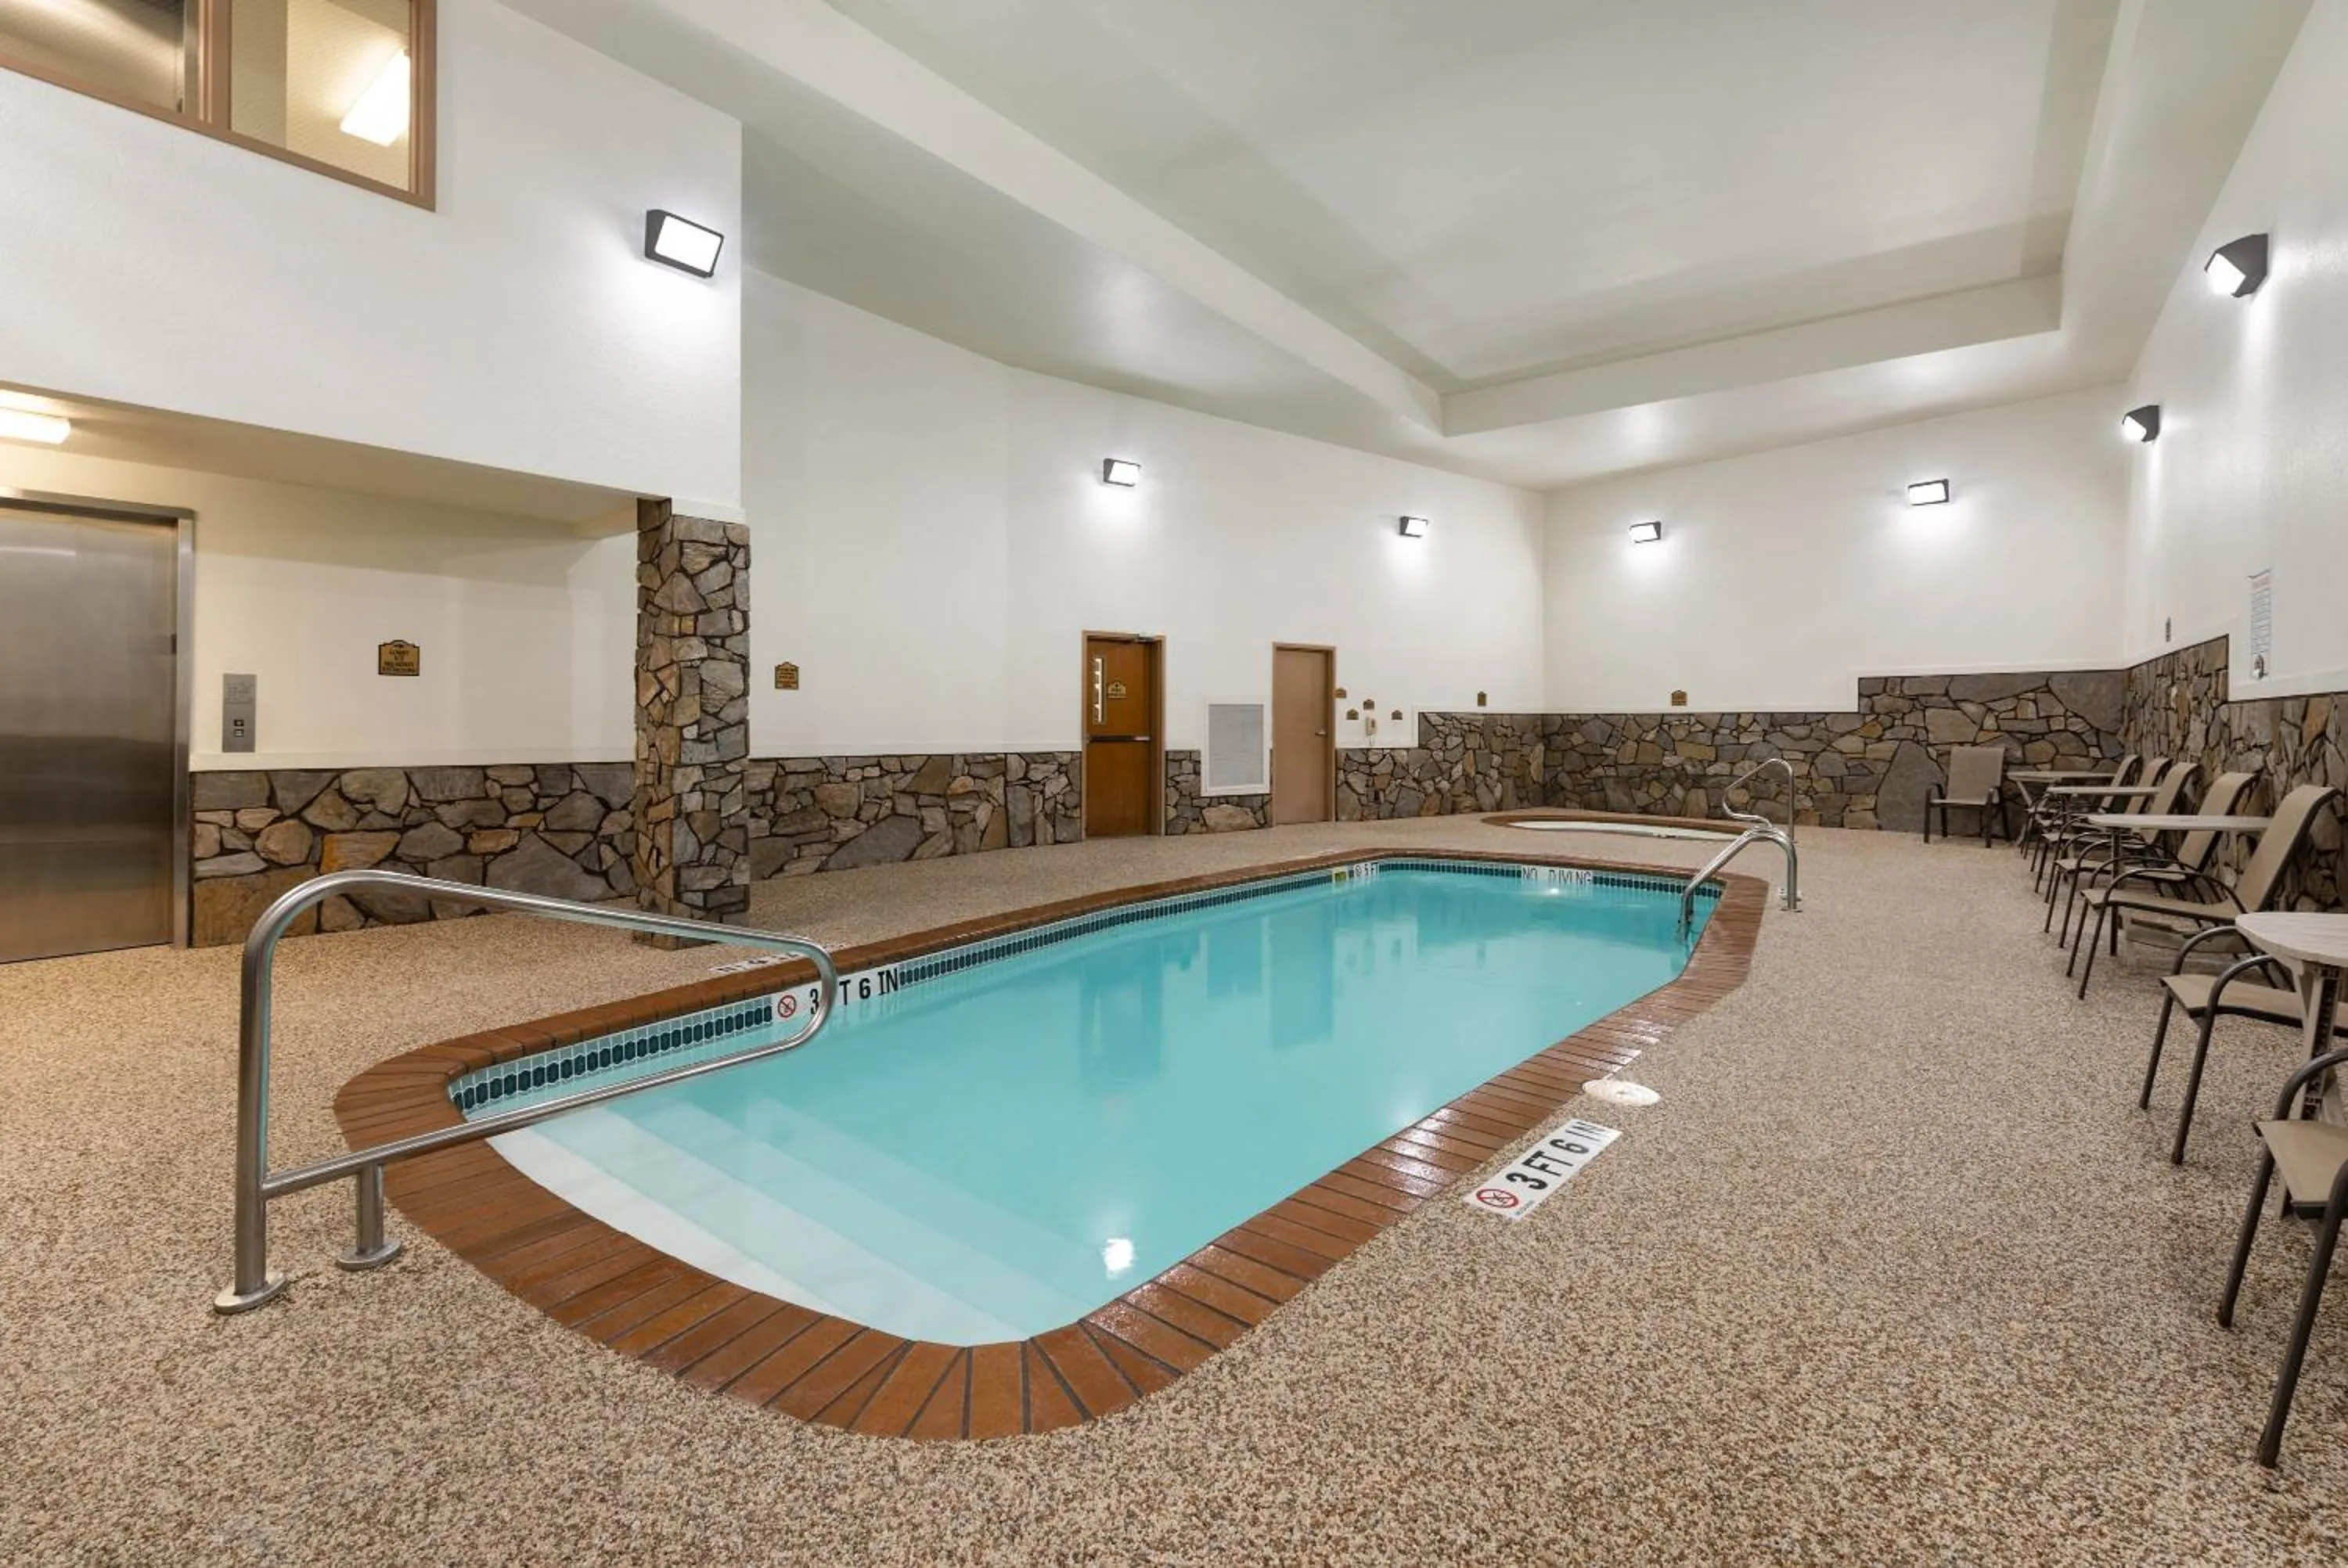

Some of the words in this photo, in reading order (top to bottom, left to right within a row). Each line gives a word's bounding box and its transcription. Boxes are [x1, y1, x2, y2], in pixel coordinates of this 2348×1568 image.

[1522, 867, 1538, 880] NO
[1549, 869, 1591, 886] DIVING
[809, 988, 820, 1015] 3
[859, 977, 871, 999] 6
[877, 969, 899, 995] IN
[1565, 1121, 1605, 1142] IN
[1549, 1138, 1590, 1154] 6
[1522, 1150, 1573, 1176] FT
[1505, 1172, 1548, 1190] 3
